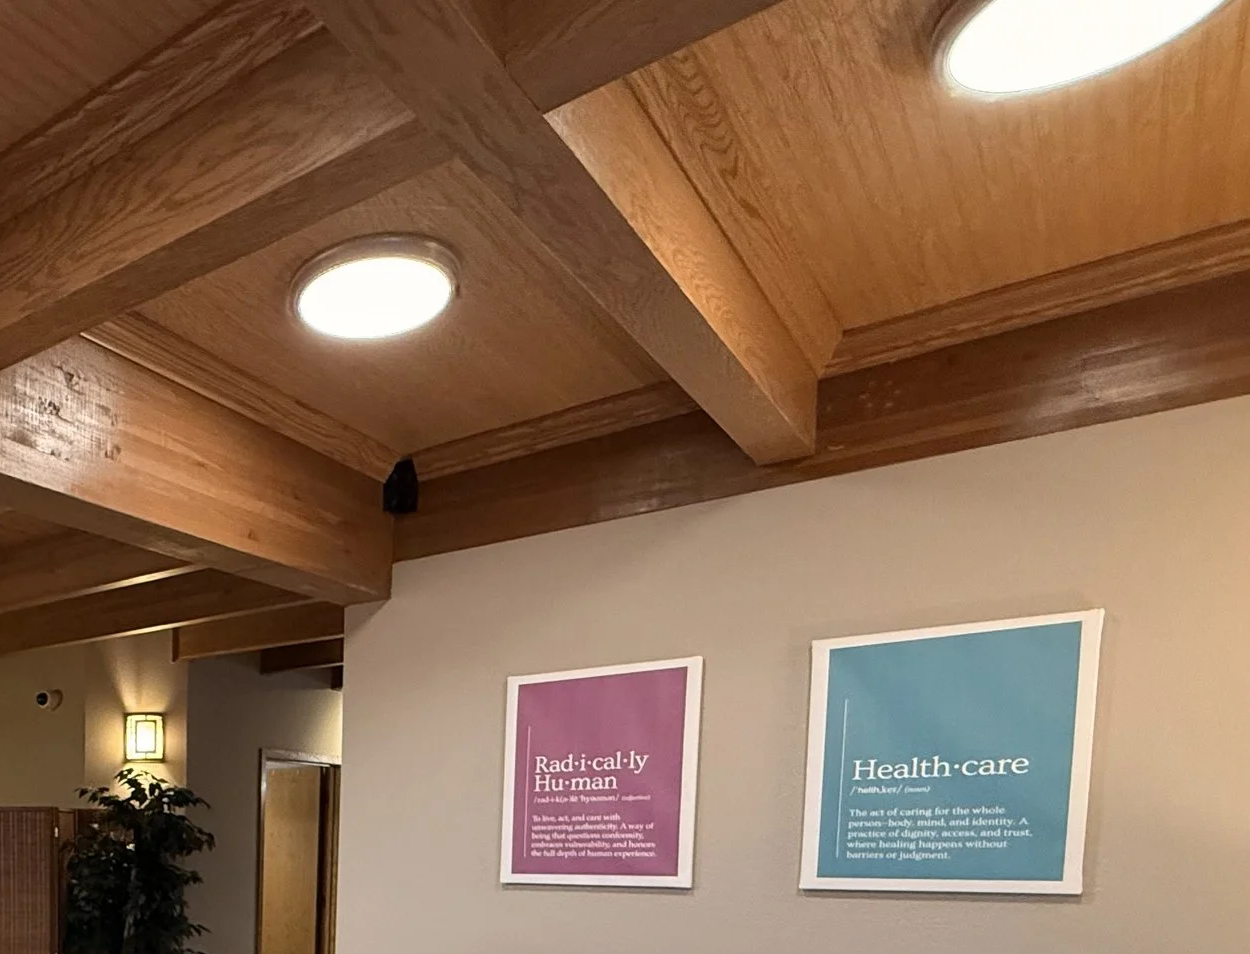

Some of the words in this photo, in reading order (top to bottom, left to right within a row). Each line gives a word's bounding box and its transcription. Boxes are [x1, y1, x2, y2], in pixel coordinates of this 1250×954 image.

[852, 755, 1030, 780] Health·care
[534, 774, 618, 792] Hu·man
[850, 808, 868, 817] The
[869, 809, 884, 817] act
[886, 807, 898, 817] of
[899, 807, 932, 817] caring
[934, 806, 950, 815] for
[952, 806, 970, 815] the
[972, 805, 1005, 815] whole
[917, 818, 947, 827] mind,
[949, 818, 970, 826] and
[972, 817, 1016, 828] identity.
[1019, 817, 1029, 825] A
[531, 832, 550, 840] being
[552, 831, 565, 839] that
[847, 831, 886, 840] practice
[888, 829, 899, 838] of
[900, 829, 939, 839] dignity,
[941, 830, 978, 838] access,
[980, 828, 1001, 837] and
[612, 840, 626, 848] and
[846, 840, 877, 849] where
[878, 840, 916, 850] healing
[918, 839, 963, 850] happens
[965, 839, 1008, 849] without
[531, 849, 542, 857] the
[556, 849, 577, 858] depth
[578, 849, 587, 857] of
[587, 849, 612, 857] human
[846, 851, 884, 859] barriers
[897, 851, 951, 861] judgment.
